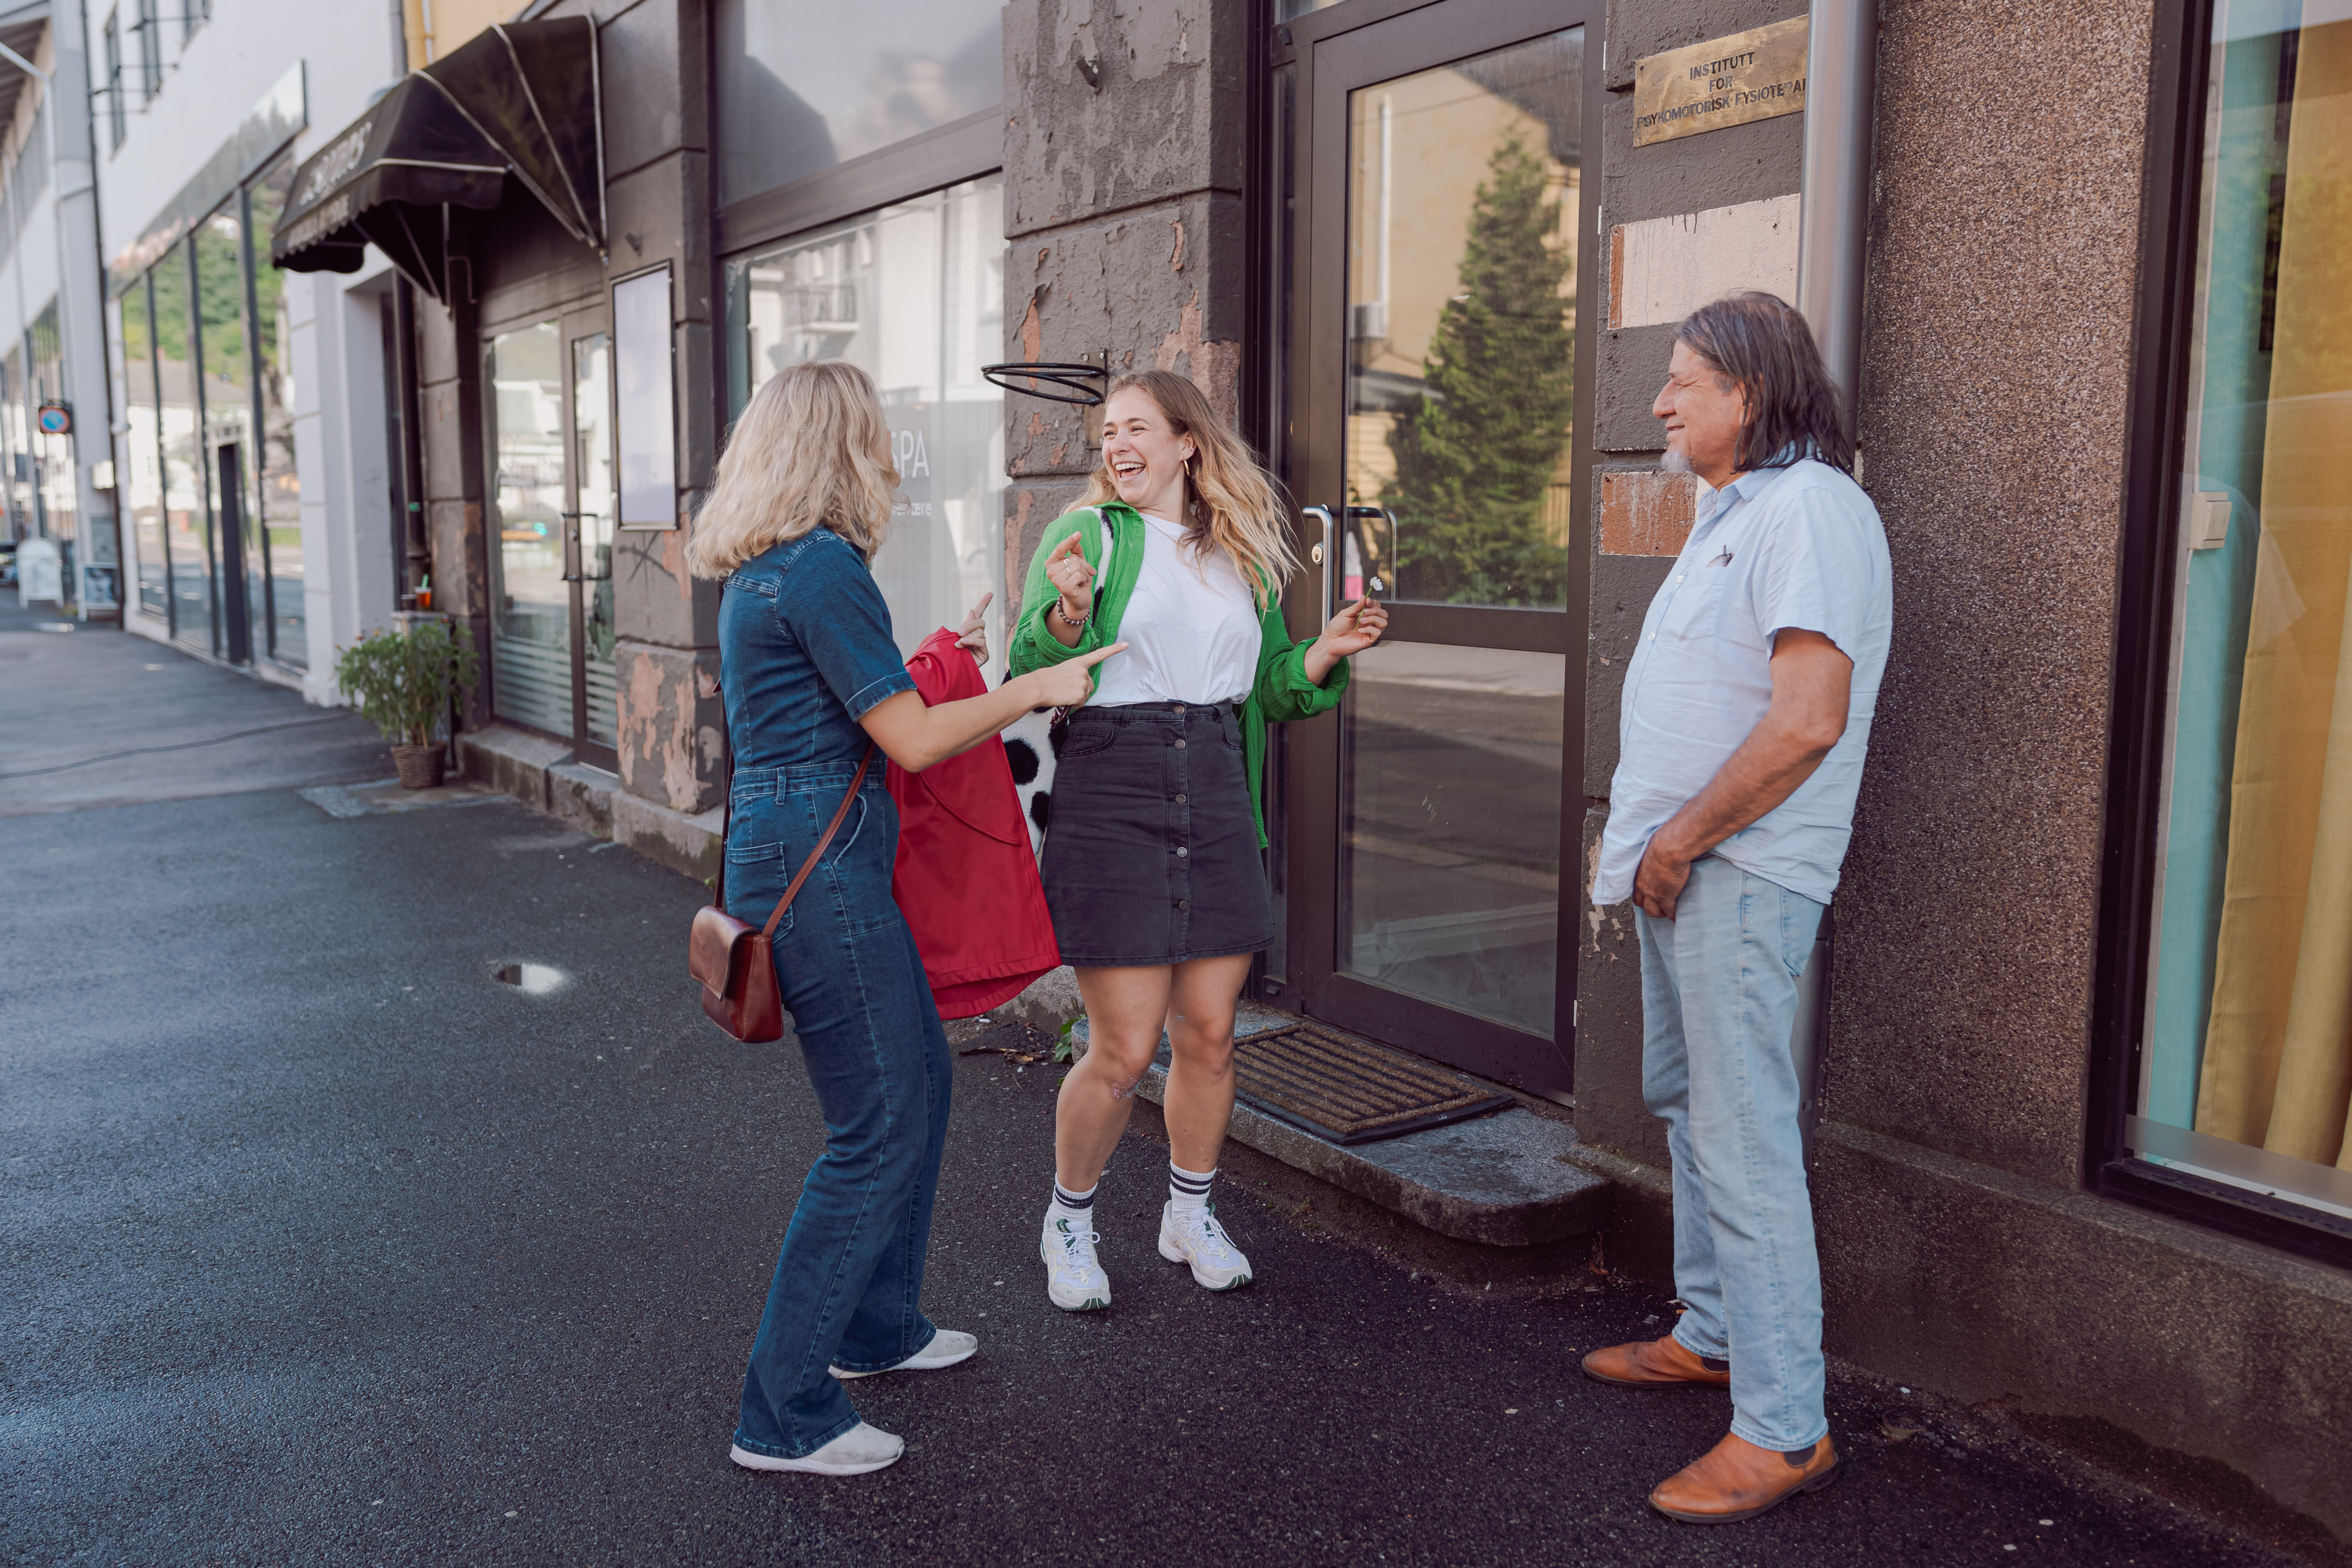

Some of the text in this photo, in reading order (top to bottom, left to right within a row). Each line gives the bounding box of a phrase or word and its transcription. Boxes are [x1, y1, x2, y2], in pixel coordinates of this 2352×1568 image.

[1690, 51, 1755, 80] INSTITUTT
[1709, 75, 1733, 92] FOR
[1637, 97, 1730, 128] PSYKOMOTORISK
